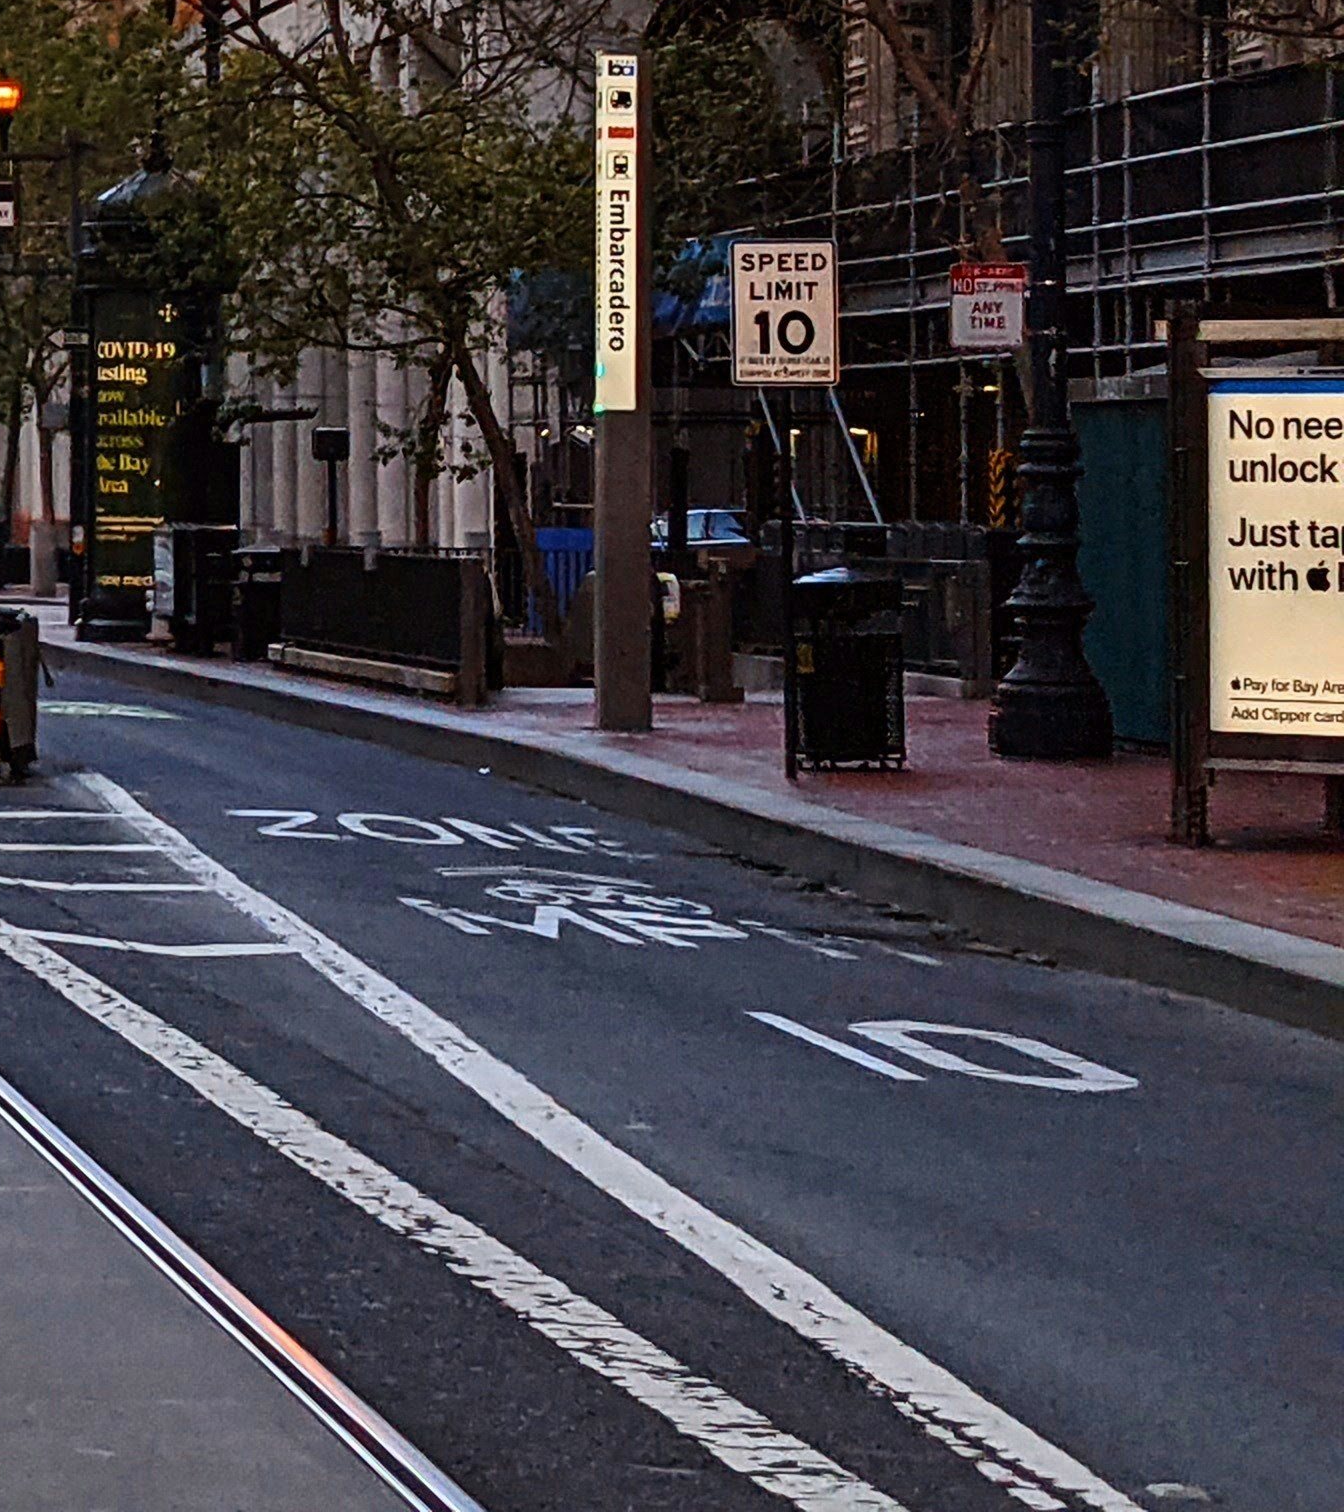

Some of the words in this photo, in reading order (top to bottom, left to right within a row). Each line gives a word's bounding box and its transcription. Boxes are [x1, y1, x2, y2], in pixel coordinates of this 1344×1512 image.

[608, 189, 631, 352] Embarcadero
[740, 252, 827, 272] SPEED
[749, 281, 819, 301] LIMIT
[953, 277, 972, 293] NO
[972, 301, 1003, 314] ANY
[754, 309, 815, 355] 10
[970, 315, 1006, 329] TIME
[1229, 409, 1275, 440] No
[119, 453, 152, 477] Bay
[1228, 453, 1339, 483] unlock
[1227, 516, 1301, 548] Just
[1307, 520, 1344, 556] ta
[1227, 559, 1299, 591] with
[1243, 677, 1269, 695] Pay
[1272, 678, 1291, 692] for
[1293, 679, 1319, 697] Bay
[1231, 706, 1259, 720] Add
[1262, 707, 1312, 724] Clipper
[223, 808, 659, 861] ZONE
[747, 1010, 1139, 1092] 10
